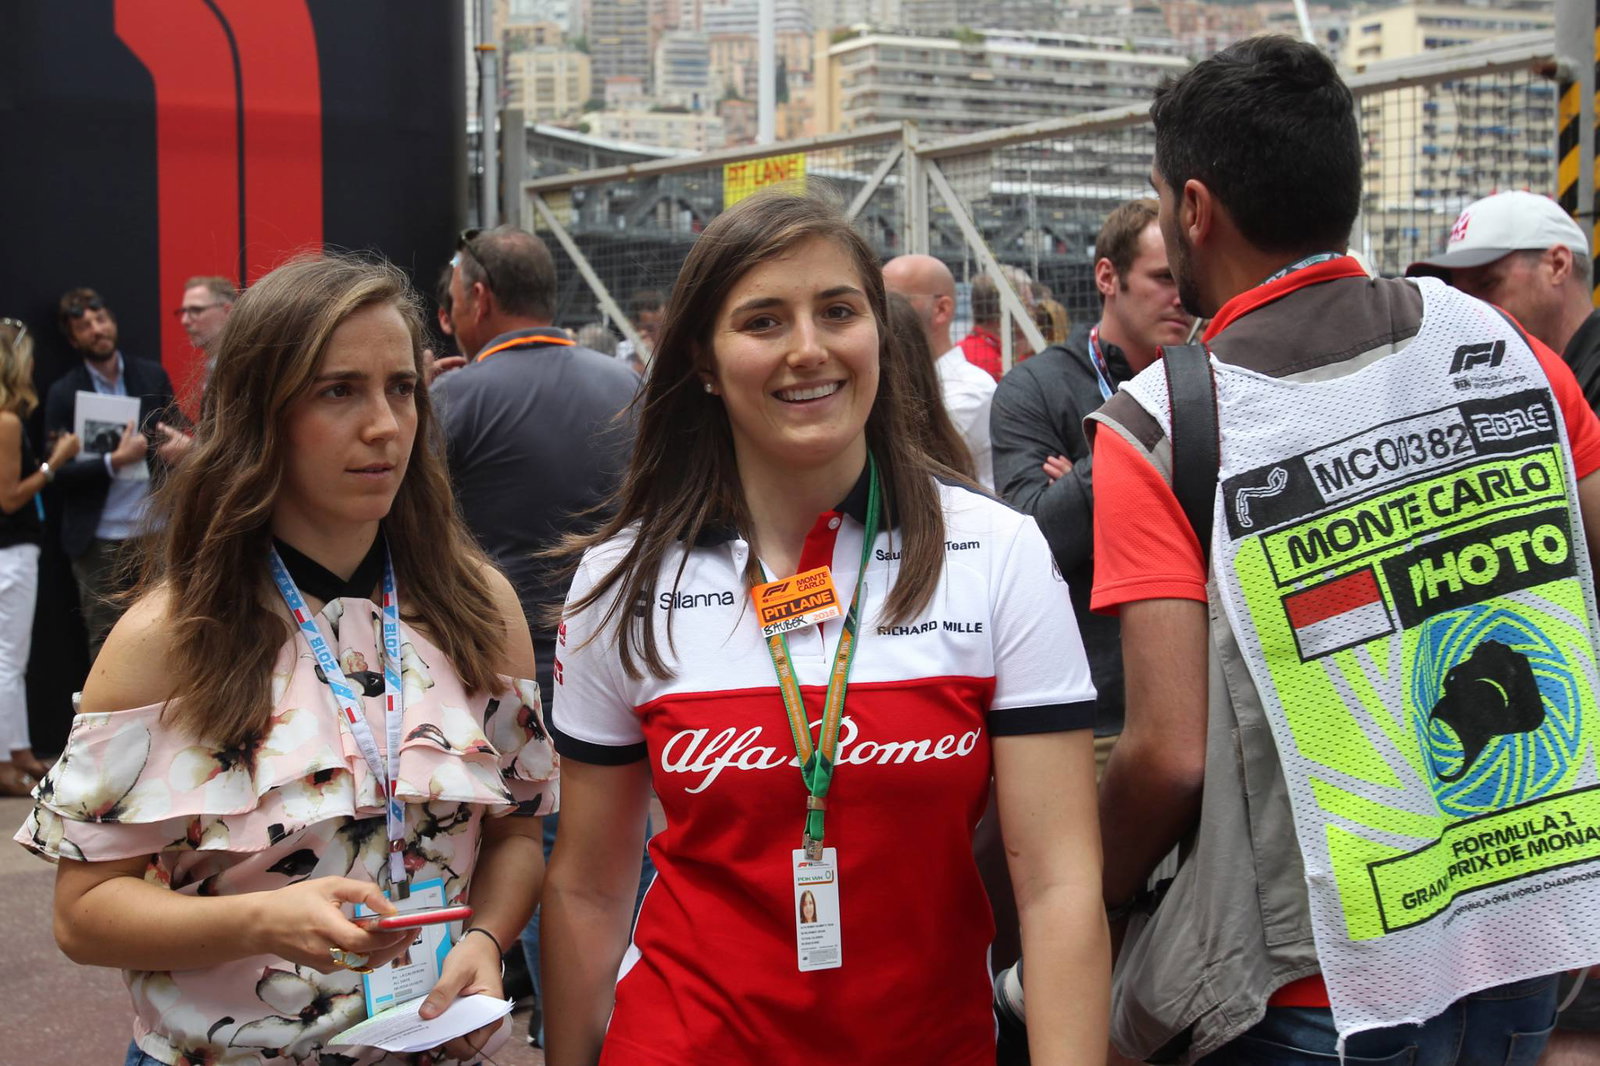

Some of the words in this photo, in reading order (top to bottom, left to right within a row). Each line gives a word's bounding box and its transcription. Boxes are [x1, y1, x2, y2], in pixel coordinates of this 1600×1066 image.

[1288, 493, 1424, 569] MONTE
[1428, 462, 1550, 518] CARLO
[944, 541, 980, 551] Team
[796, 571, 828, 586] MONTE
[1408, 524, 1568, 608] PHOTO
[798, 579, 826, 592] CARLO
[659, 591, 734, 610] Silanna
[764, 604, 788, 620] PIT
[790, 591, 832, 613] LANE
[763, 615, 808, 635] SAUBER
[813, 609, 836, 621] 2018
[385, 622, 398, 658] 2018
[877, 621, 937, 636] RICHARD
[943, 620, 983, 633] MILLE
[310, 636, 336, 673] 2018
[660, 726, 788, 794] Alfa
[788, 716, 981, 767] Romeo
[1452, 815, 1560, 859] FORMULA
[1560, 811, 1577, 827] 1
[1402, 873, 1449, 909] GRAN
[1447, 854, 1494, 882] PRIX
[1497, 844, 1525, 866] DE
[1528, 826, 1600, 858] MONA
[1492, 893, 1511, 905] ONE
[1511, 884, 1543, 899] WORLD
